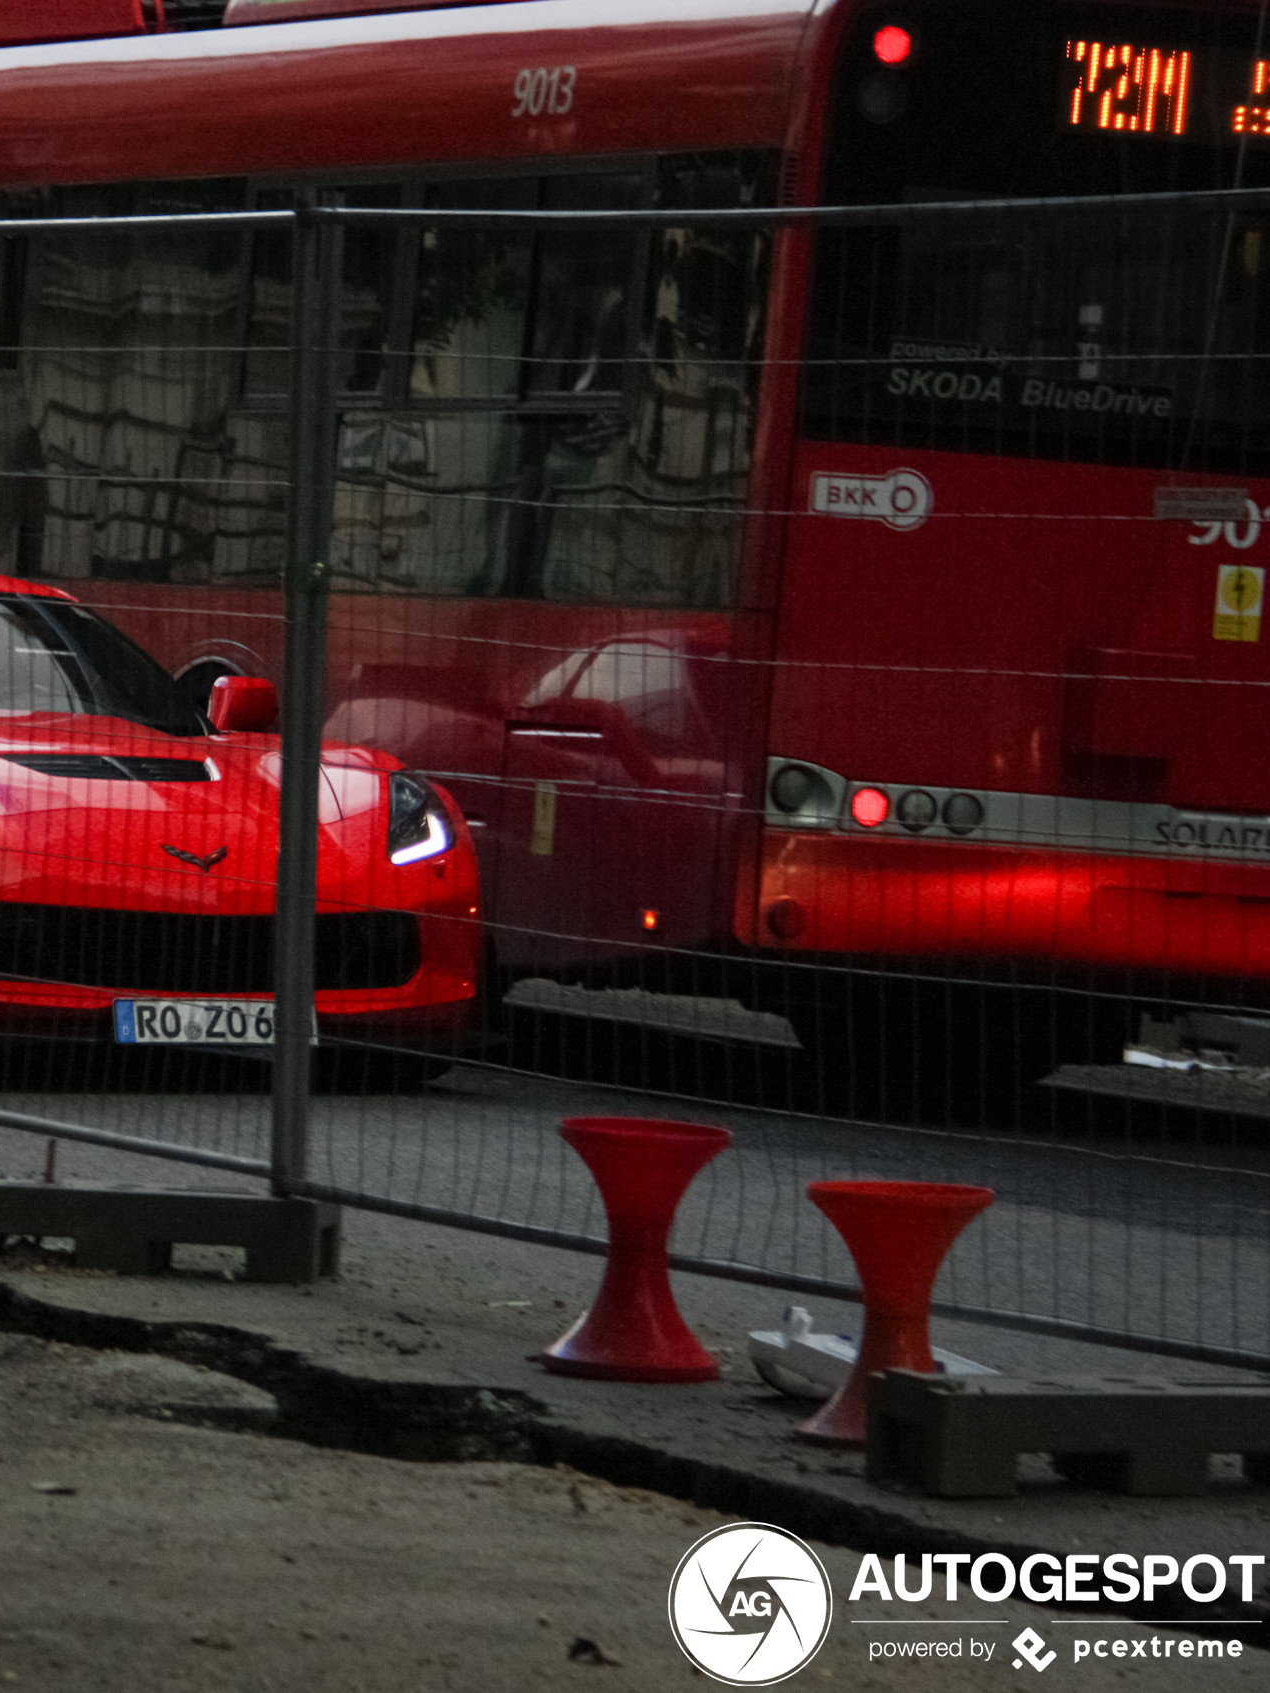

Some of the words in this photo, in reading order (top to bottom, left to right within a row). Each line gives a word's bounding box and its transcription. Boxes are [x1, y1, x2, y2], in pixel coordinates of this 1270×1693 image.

[511, 65, 576, 117] 9013
[886, 367, 1002, 402] SKODA
[1019, 379, 1172, 418] BlueDrive
[828, 485, 877, 506] BKK
[135, 1004, 181, 1039] RO
